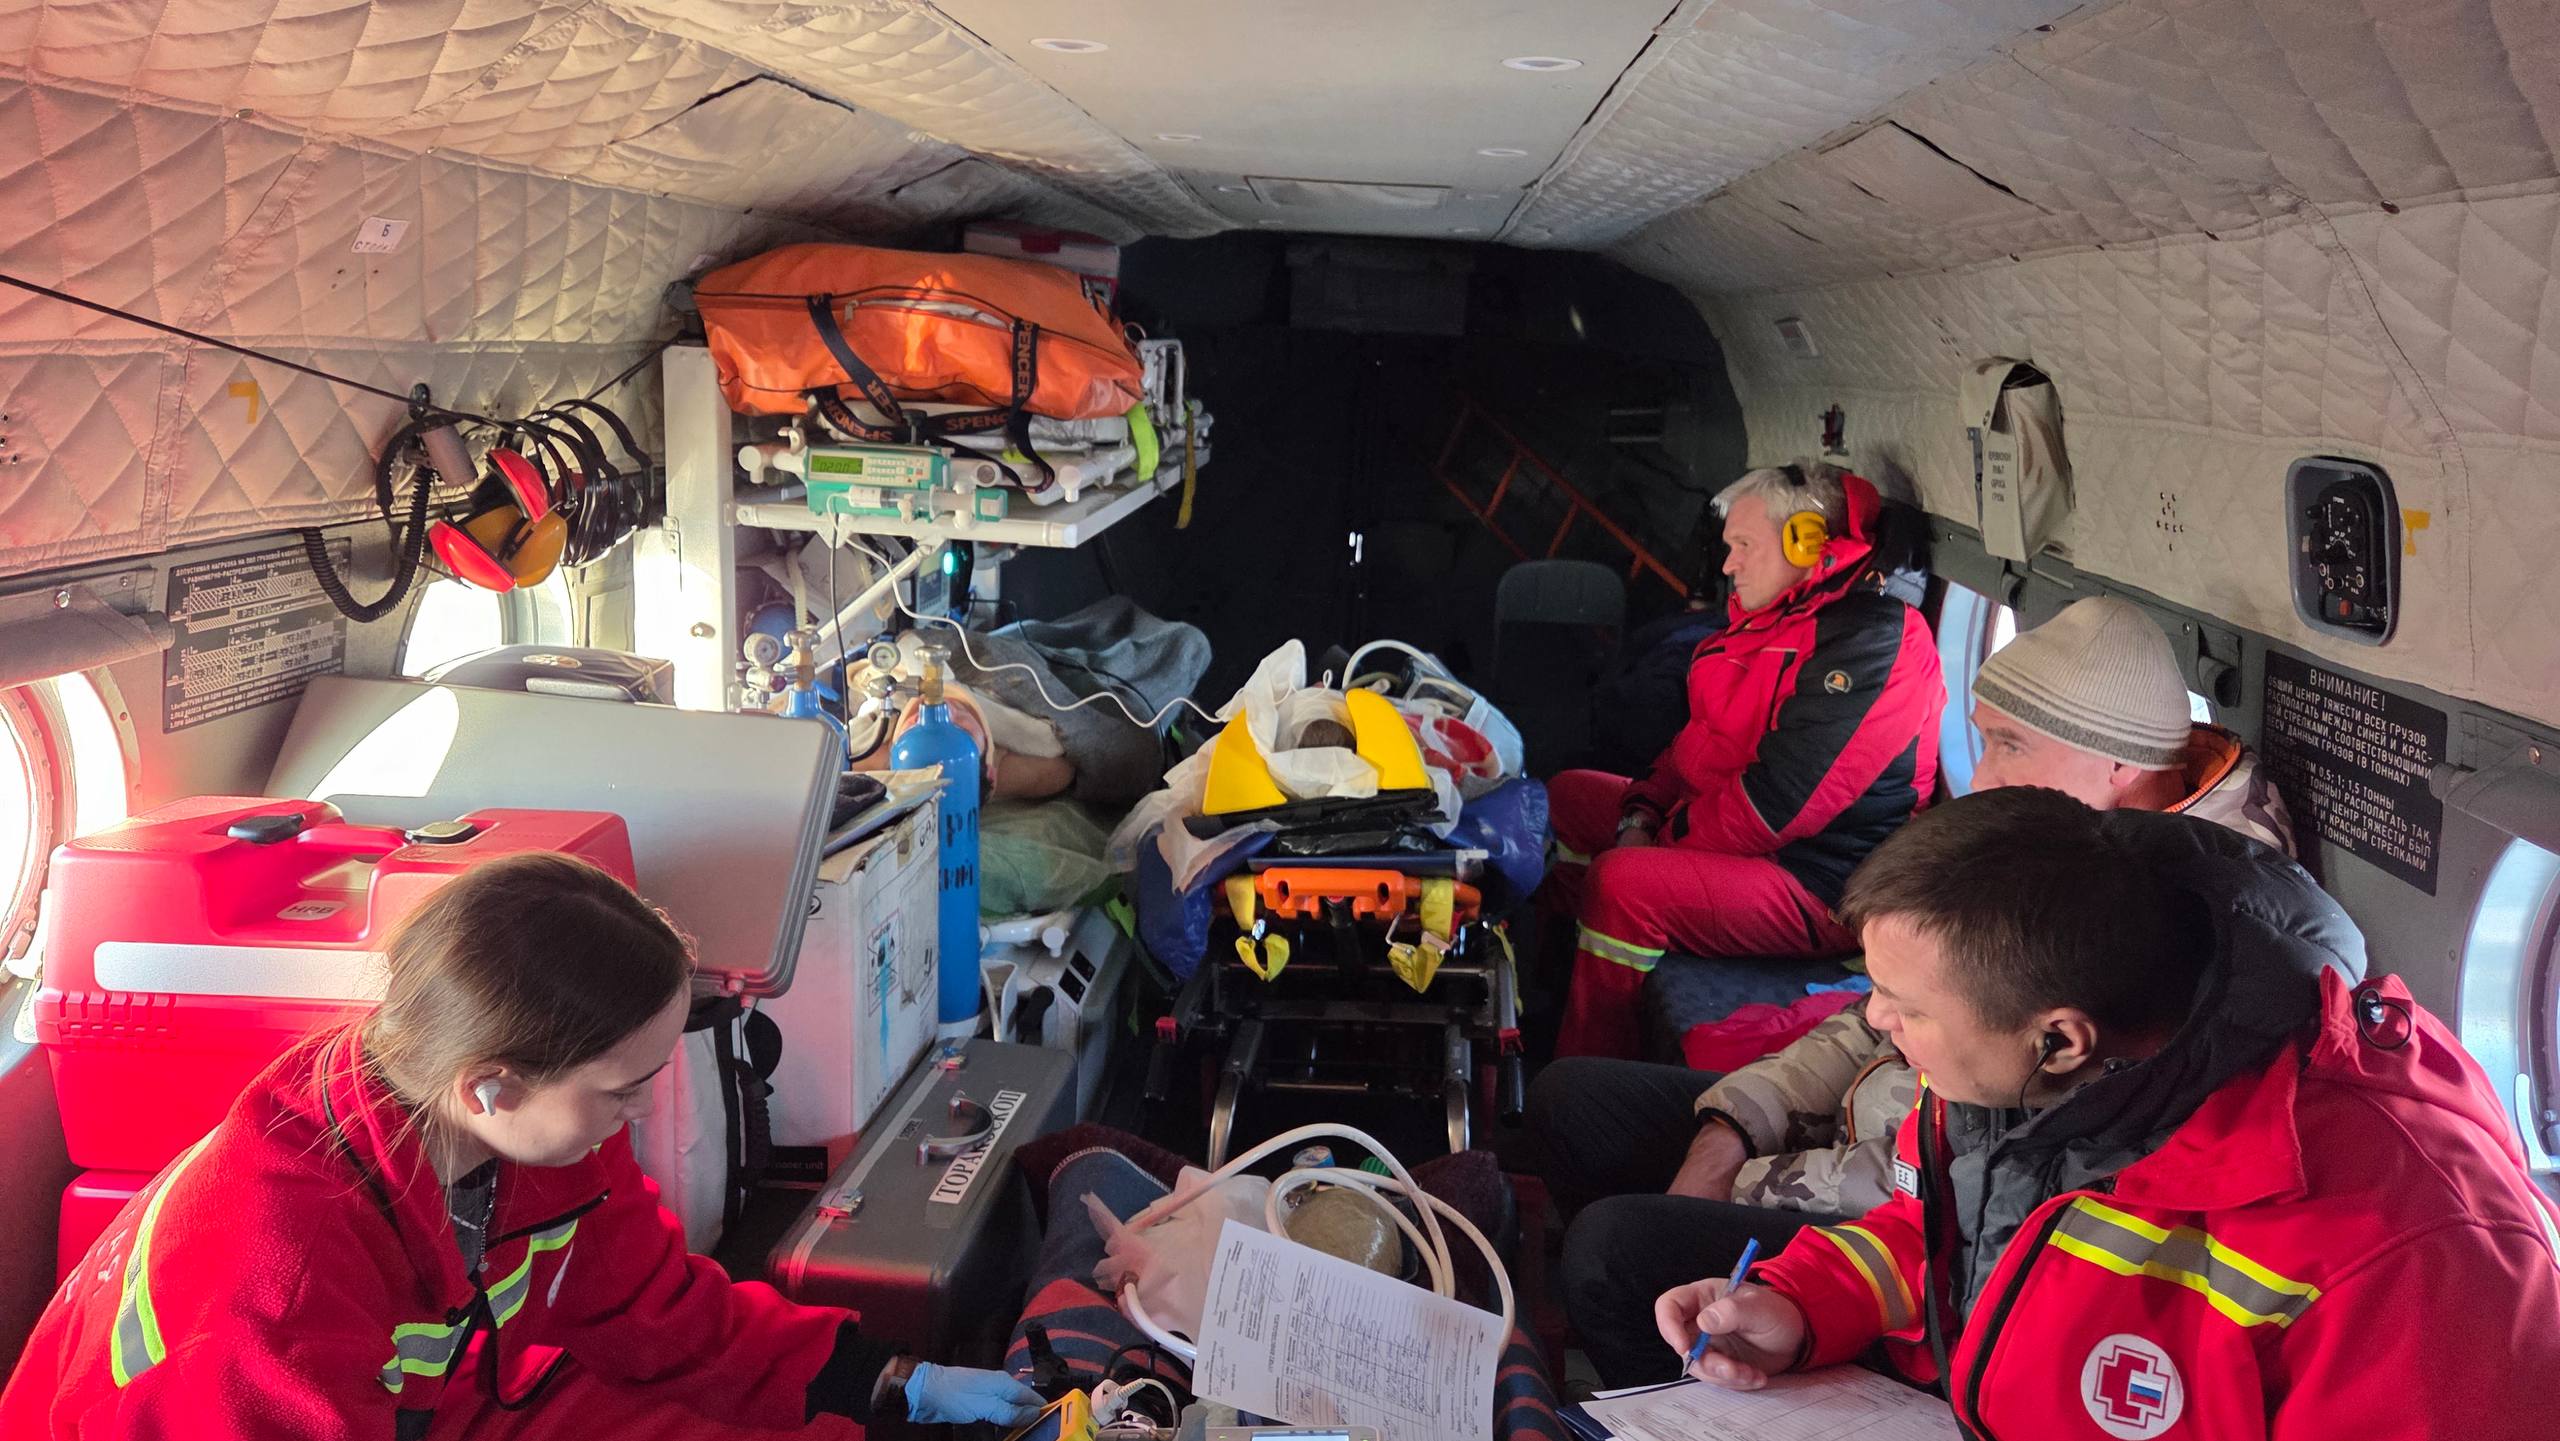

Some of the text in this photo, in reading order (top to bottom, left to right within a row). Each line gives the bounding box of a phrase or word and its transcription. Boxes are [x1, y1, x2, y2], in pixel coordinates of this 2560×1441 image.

[2295, 686, 2320, 705] ЦЕНТР
[2323, 696, 2361, 721] ТЯЖЕСТИ
[2364, 712, 2387, 732] ВСЕХ
[2389, 722, 2427, 747] ГРУЗОВ
[2310, 669, 2385, 711] ВНИМАНИЕ!
[2267, 688, 2433, 763] РАСПОЛАГАТЬ МЕЖДУ СИНЕЙ И КРАС-
[2334, 730, 2432, 780] СООТВЕТСТВУЮЩИМИ
[2287, 724, 2320, 748] ДАННЫХ
[2321, 738, 2354, 763] ГРУЗОВ
[2357, 754, 2368, 769] (В
[2371, 760, 2410, 787] ТОННАХ)
[2310, 775, 2342, 800] ТОННЫ)
[2344, 791, 2408, 832] РАСПОЛАГАТЬ
[2363, 786, 2395, 811] ТОННЫ
[2320, 809, 2326, 821] И
[2329, 813, 2368, 843] КРАСНОЙ
[2370, 834, 2427, 872] СТРЕЛКАМИ
[2324, 824, 2356, 851] ТОННЫ.
[2332, 800, 2360, 822] ЦЕНТР
[2362, 815, 2405, 846] ТЯЖЕСТИ
[2408, 838, 2431, 859] БЫЛ
[936, 1090, 1022, 1198] ТОРАКСКОП
